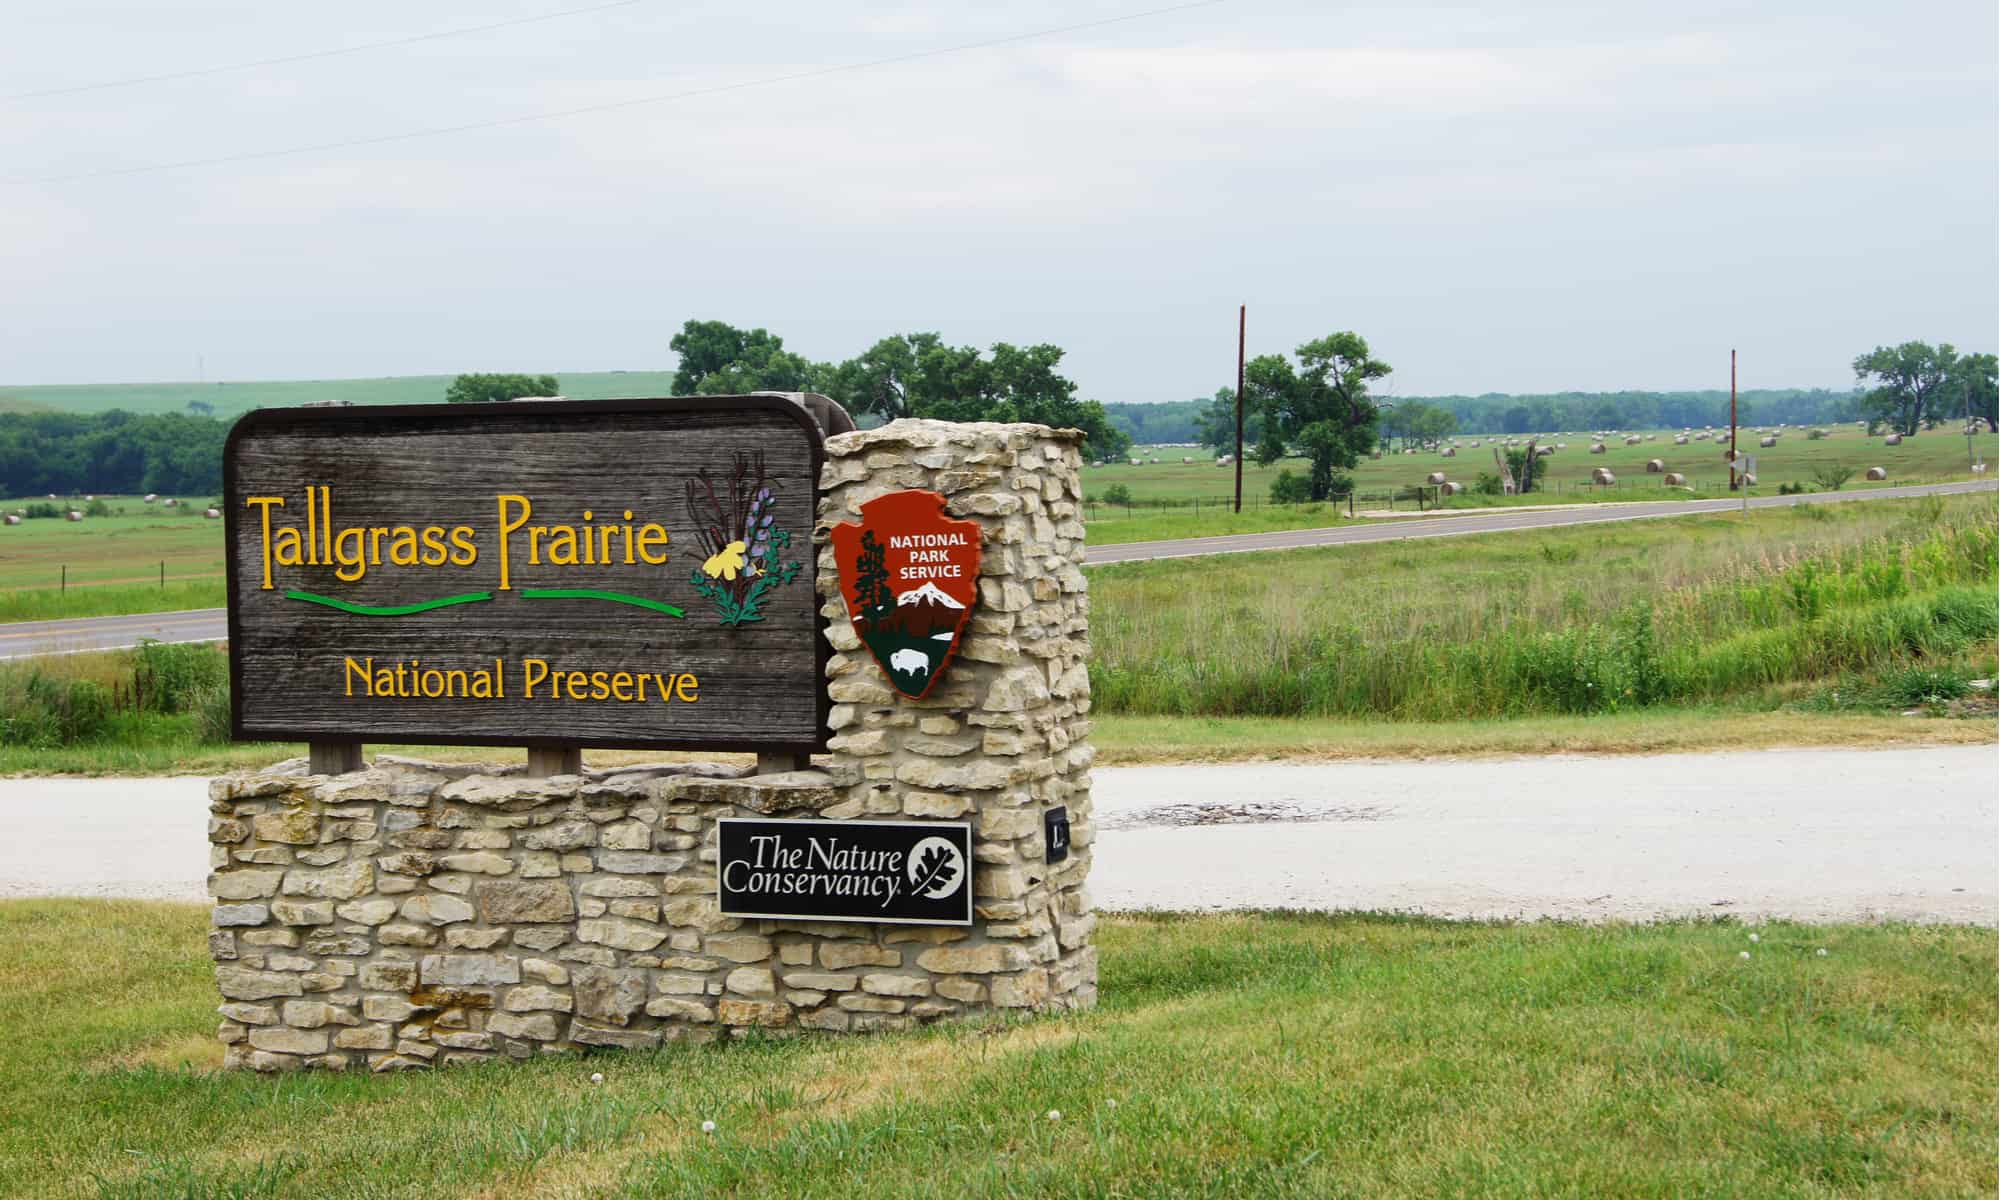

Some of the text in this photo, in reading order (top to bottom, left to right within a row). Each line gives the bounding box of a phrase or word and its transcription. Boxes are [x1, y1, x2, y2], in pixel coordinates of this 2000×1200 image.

[247, 486, 668, 589] Tallgrass Prairie
[890, 533, 968, 548] NATIONAL
[910, 550, 950, 563] PARK
[900, 565, 961, 579] SERVICE
[344, 657, 698, 701] National Preserve
[750, 834, 902, 872] The Nature
